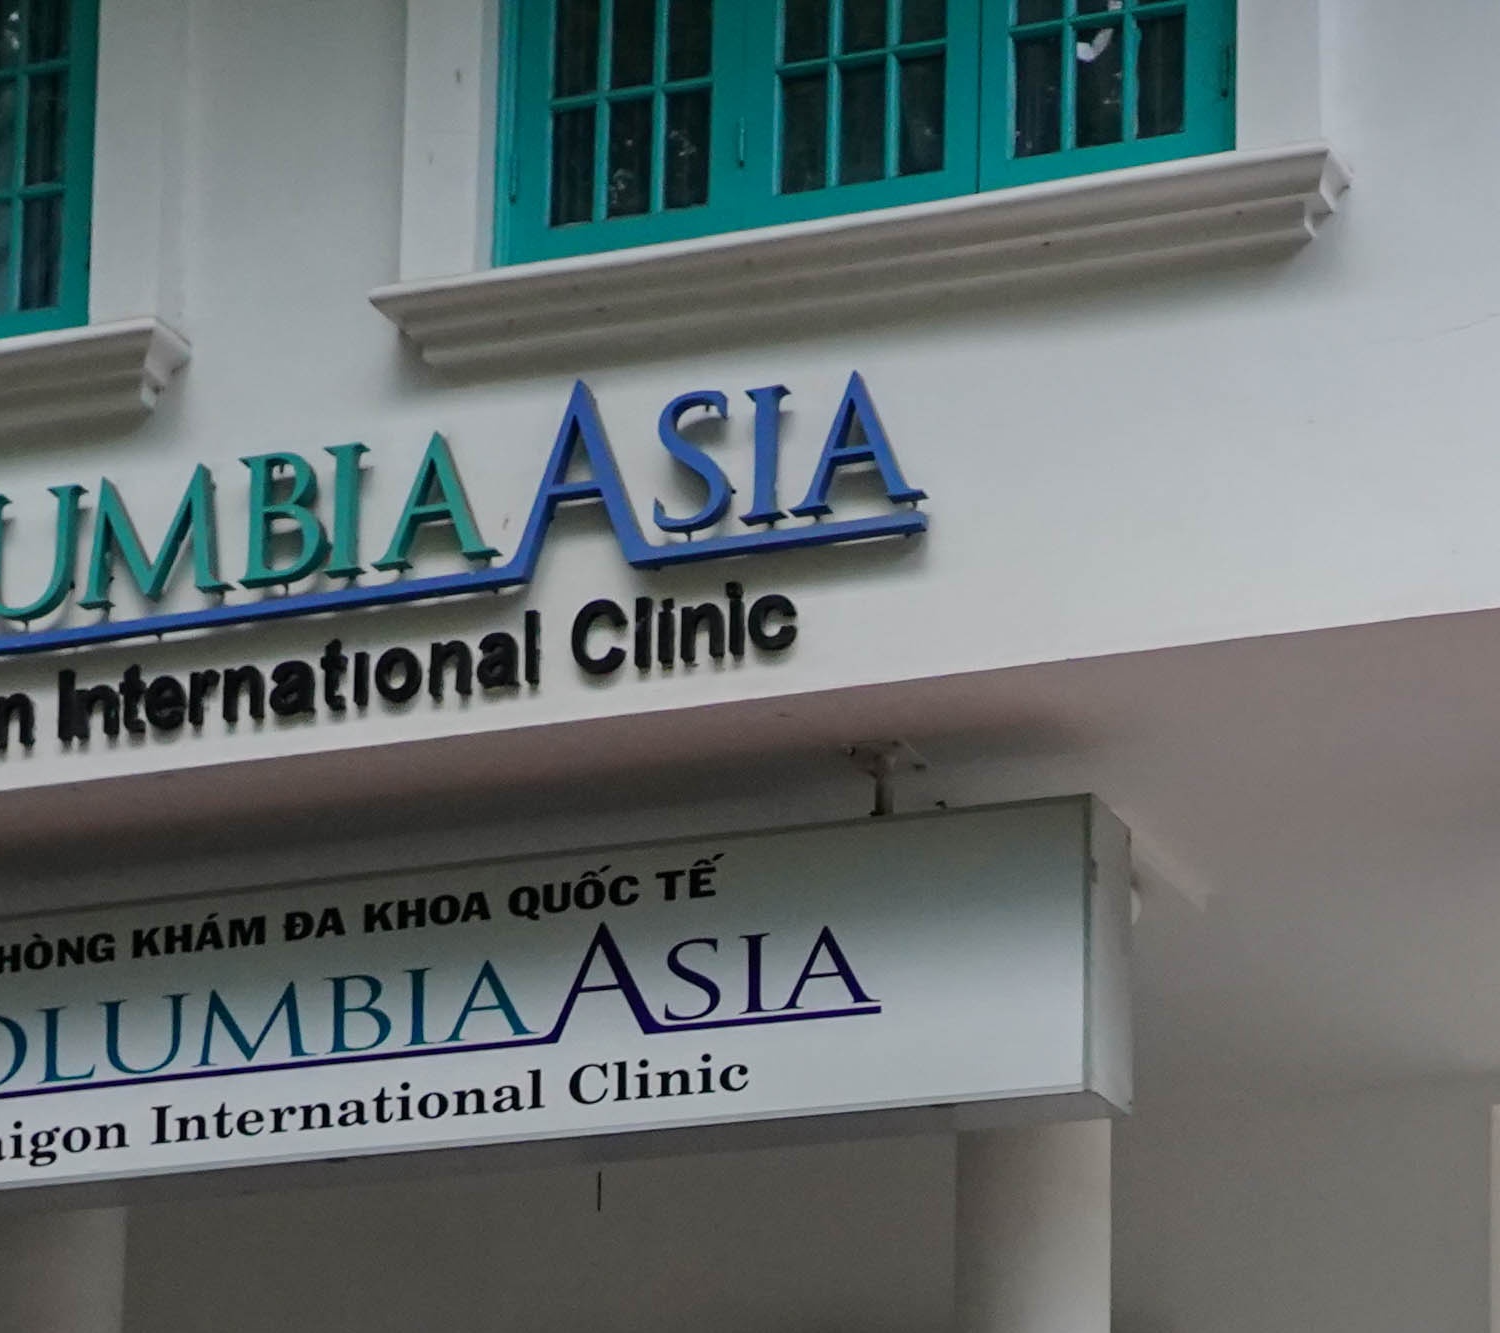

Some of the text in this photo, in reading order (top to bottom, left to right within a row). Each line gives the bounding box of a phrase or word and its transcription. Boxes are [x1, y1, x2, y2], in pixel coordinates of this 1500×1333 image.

[58, 609, 541, 746] International
[570, 581, 798, 678] Clinic
[131, 912, 267, 959] KHÁM
[282, 907, 346, 942] ĐA
[363, 891, 492, 934] KHOA
[507, 864, 640, 921] QUỐC
[654, 852, 725, 902] TẾ
[150, 1070, 545, 1145] International
[568, 1053, 749, 1105] Clinic
